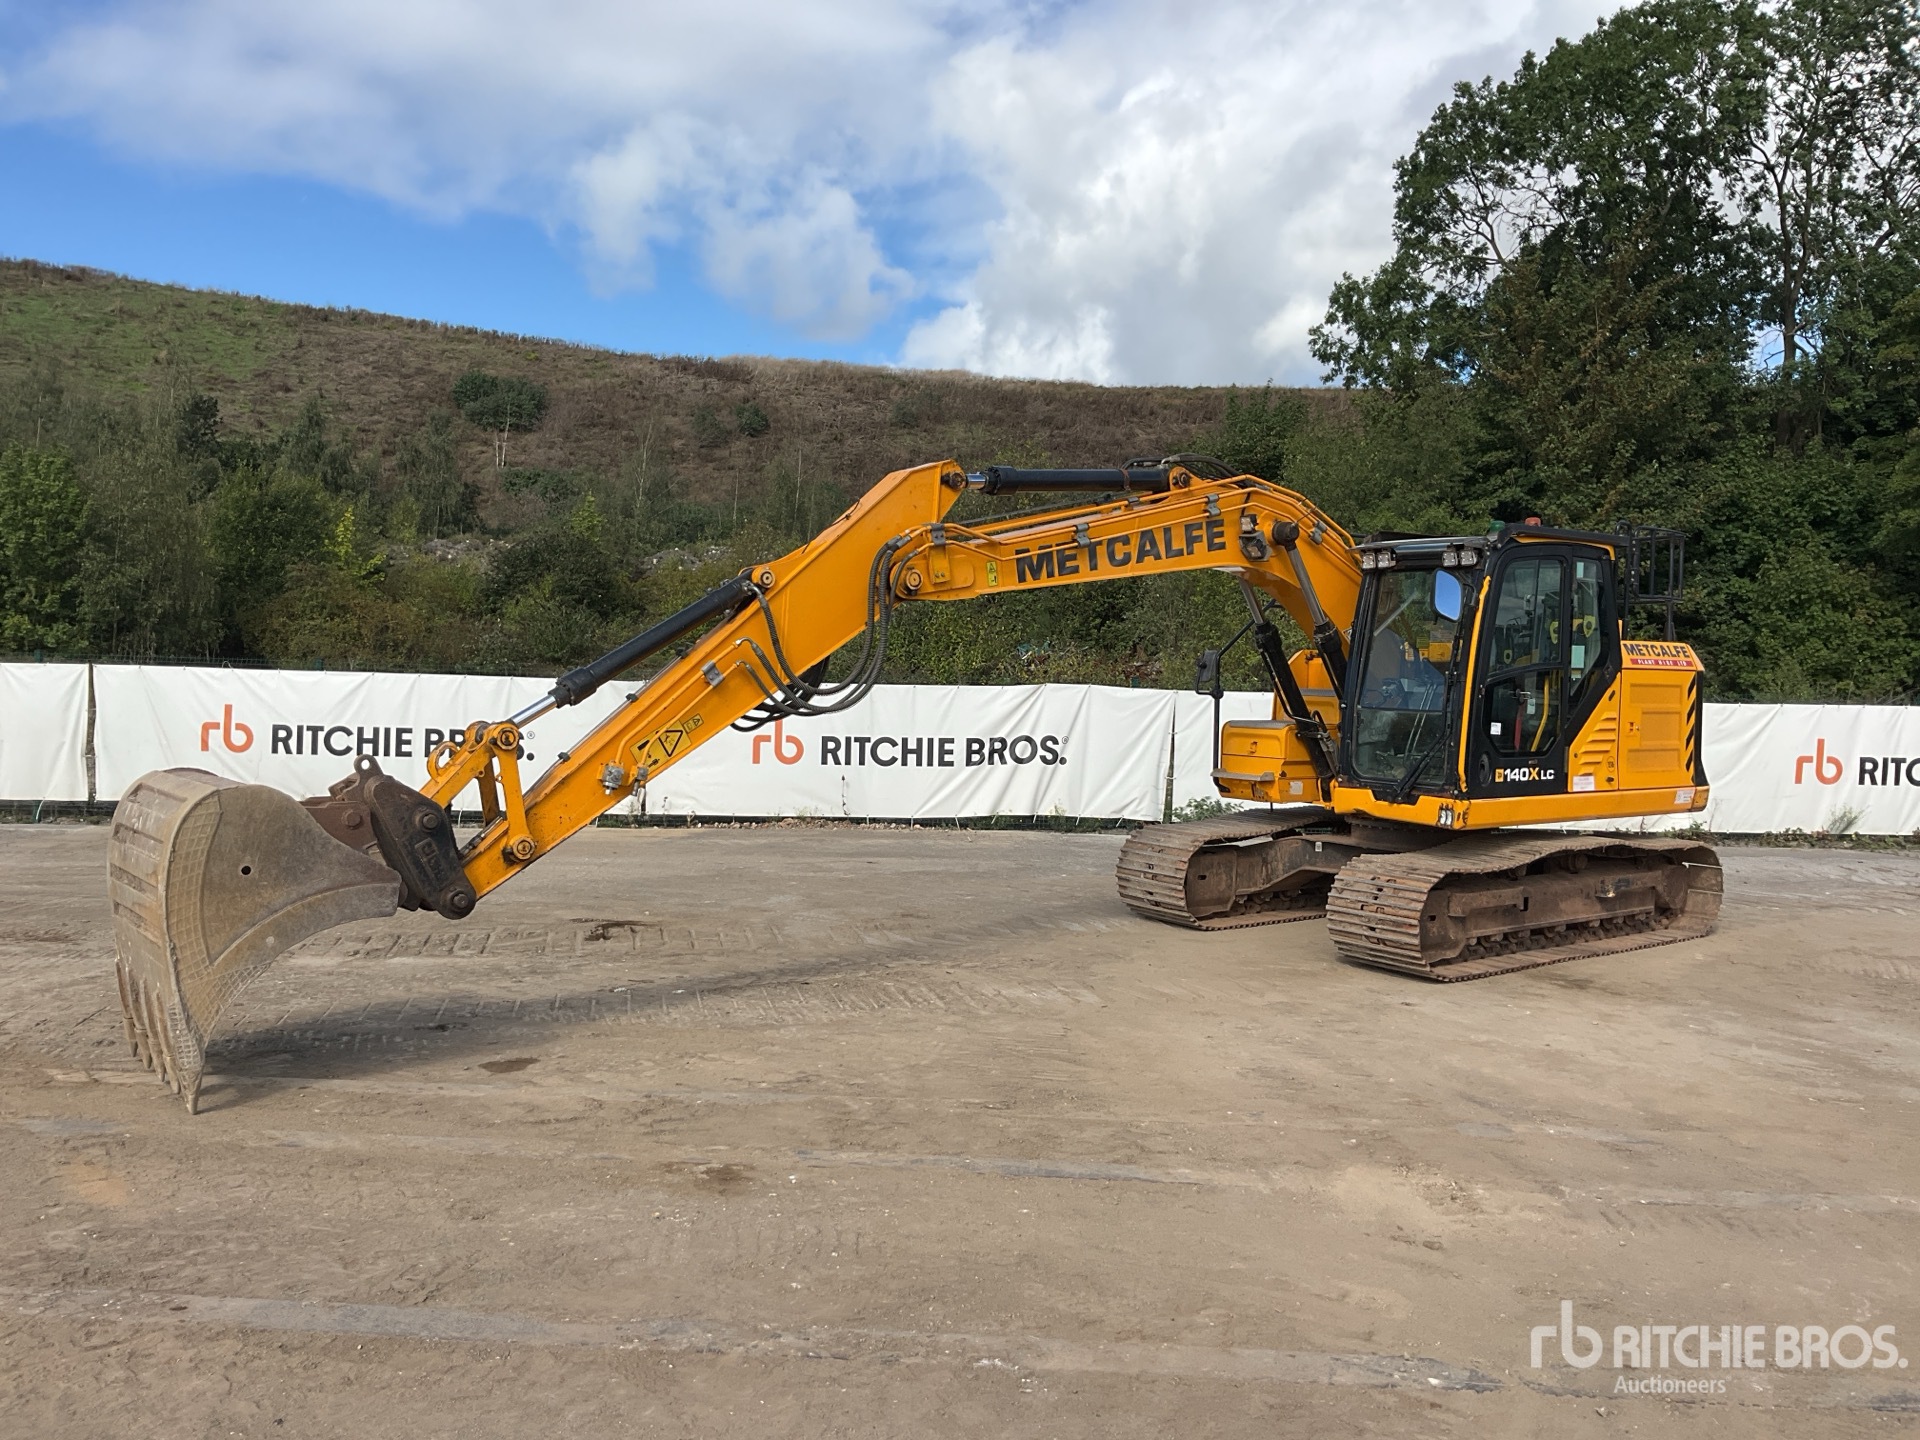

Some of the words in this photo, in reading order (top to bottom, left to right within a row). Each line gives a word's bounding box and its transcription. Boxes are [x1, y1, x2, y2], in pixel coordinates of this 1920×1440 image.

[1015, 519, 1226, 583] METCALFE
[1622, 643, 1690, 658] METCALFE
[201, 704, 253, 753] rb
[271, 724, 413, 757] RITCHIE
[752, 719, 804, 765] rb
[820, 735, 954, 767] RITCHIE
[965, 735, 1067, 767] BROS.
[1794, 738, 1843, 785] rb
